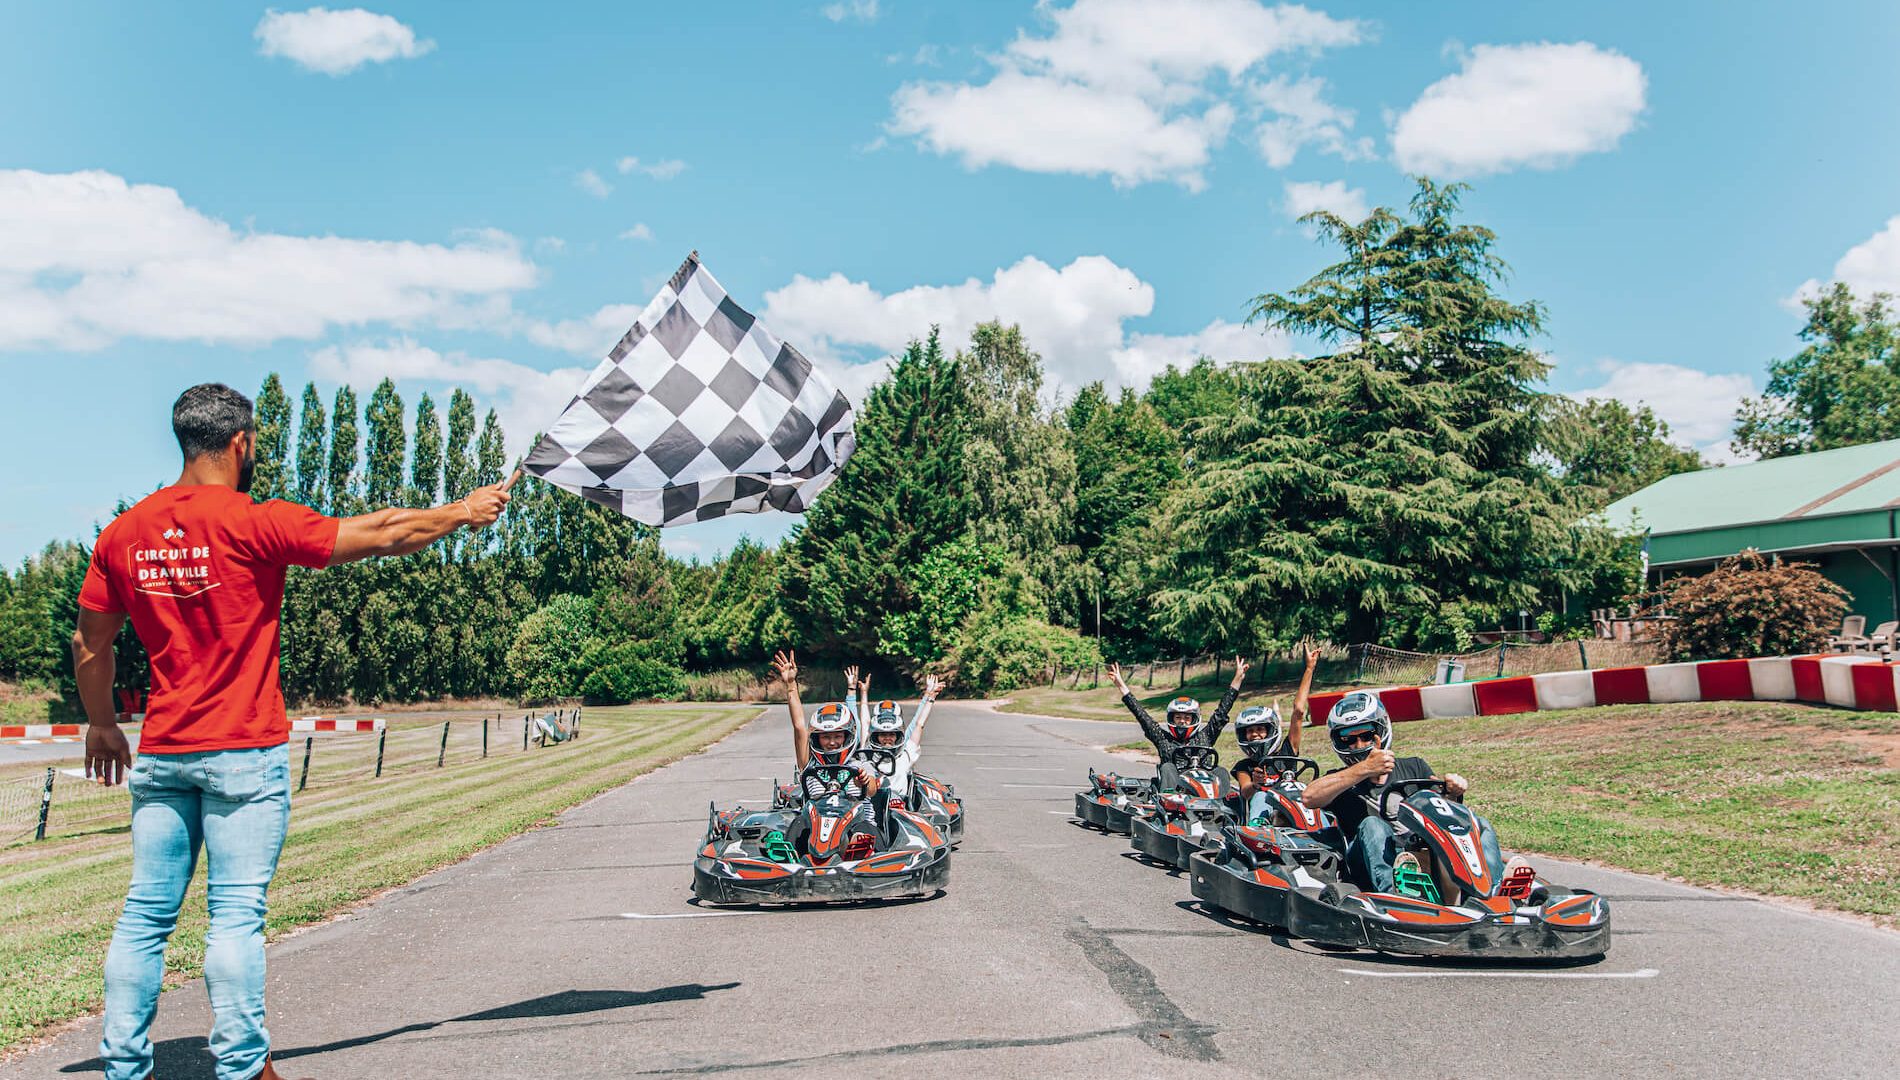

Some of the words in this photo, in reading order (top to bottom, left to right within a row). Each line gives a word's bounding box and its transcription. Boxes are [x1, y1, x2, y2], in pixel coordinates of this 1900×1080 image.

[135, 548, 188, 562] CIRCUIT
[192, 546, 210, 559] DE
[826, 794, 839, 806] 4
[1429, 797, 1454, 815] 9
